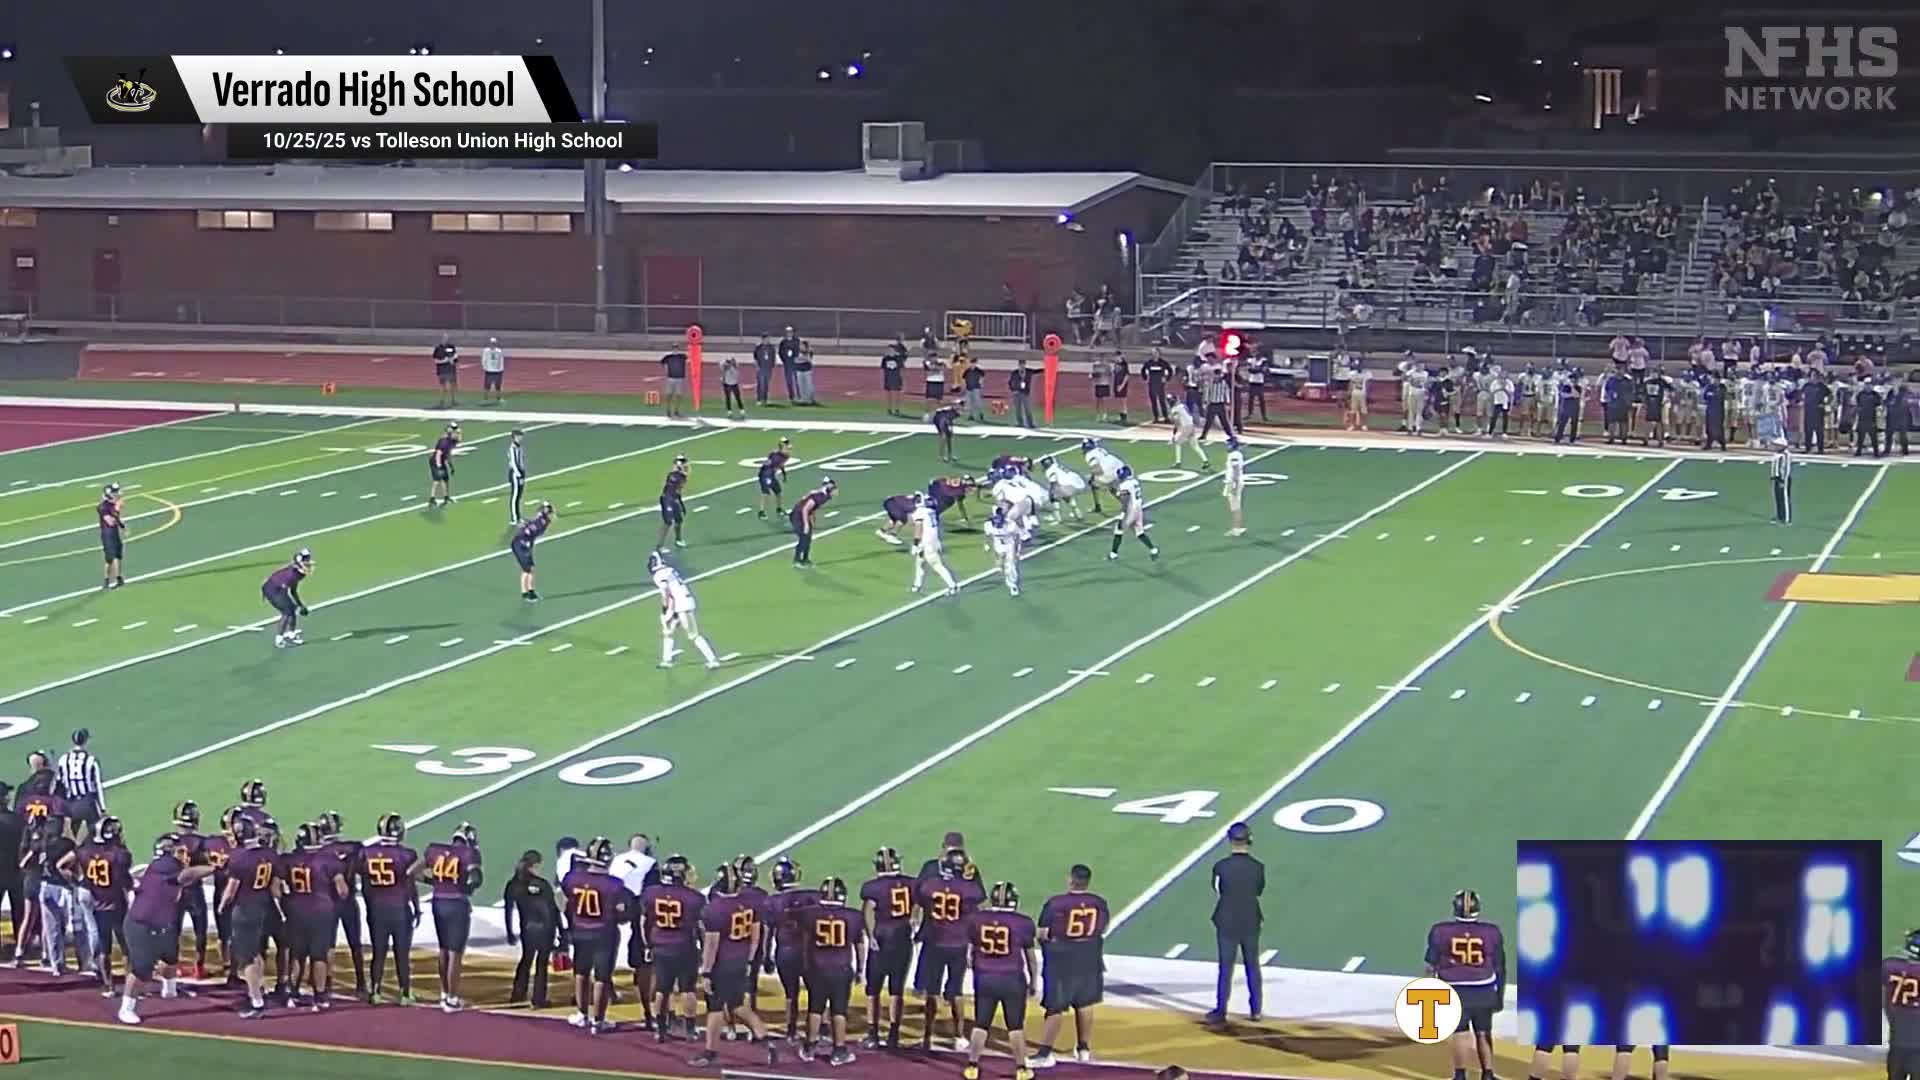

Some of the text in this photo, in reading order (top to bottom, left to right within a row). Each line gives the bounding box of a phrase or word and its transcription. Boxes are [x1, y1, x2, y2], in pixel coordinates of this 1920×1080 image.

[86, 859, 111, 886] 43
[367, 858, 396, 886] 55
[433, 855, 459, 885] 44
[573, 888, 601, 916] 70
[655, 898, 681, 929] 52
[891, 886, 910, 918] 51
[931, 892, 961, 921] 33
[815, 919, 846, 947] 50
[1066, 908, 1097, 937] 67
[980, 924, 1010, 955] 53
[1451, 937, 1484, 966] 56
[1889, 975, 1919, 1005] 72
